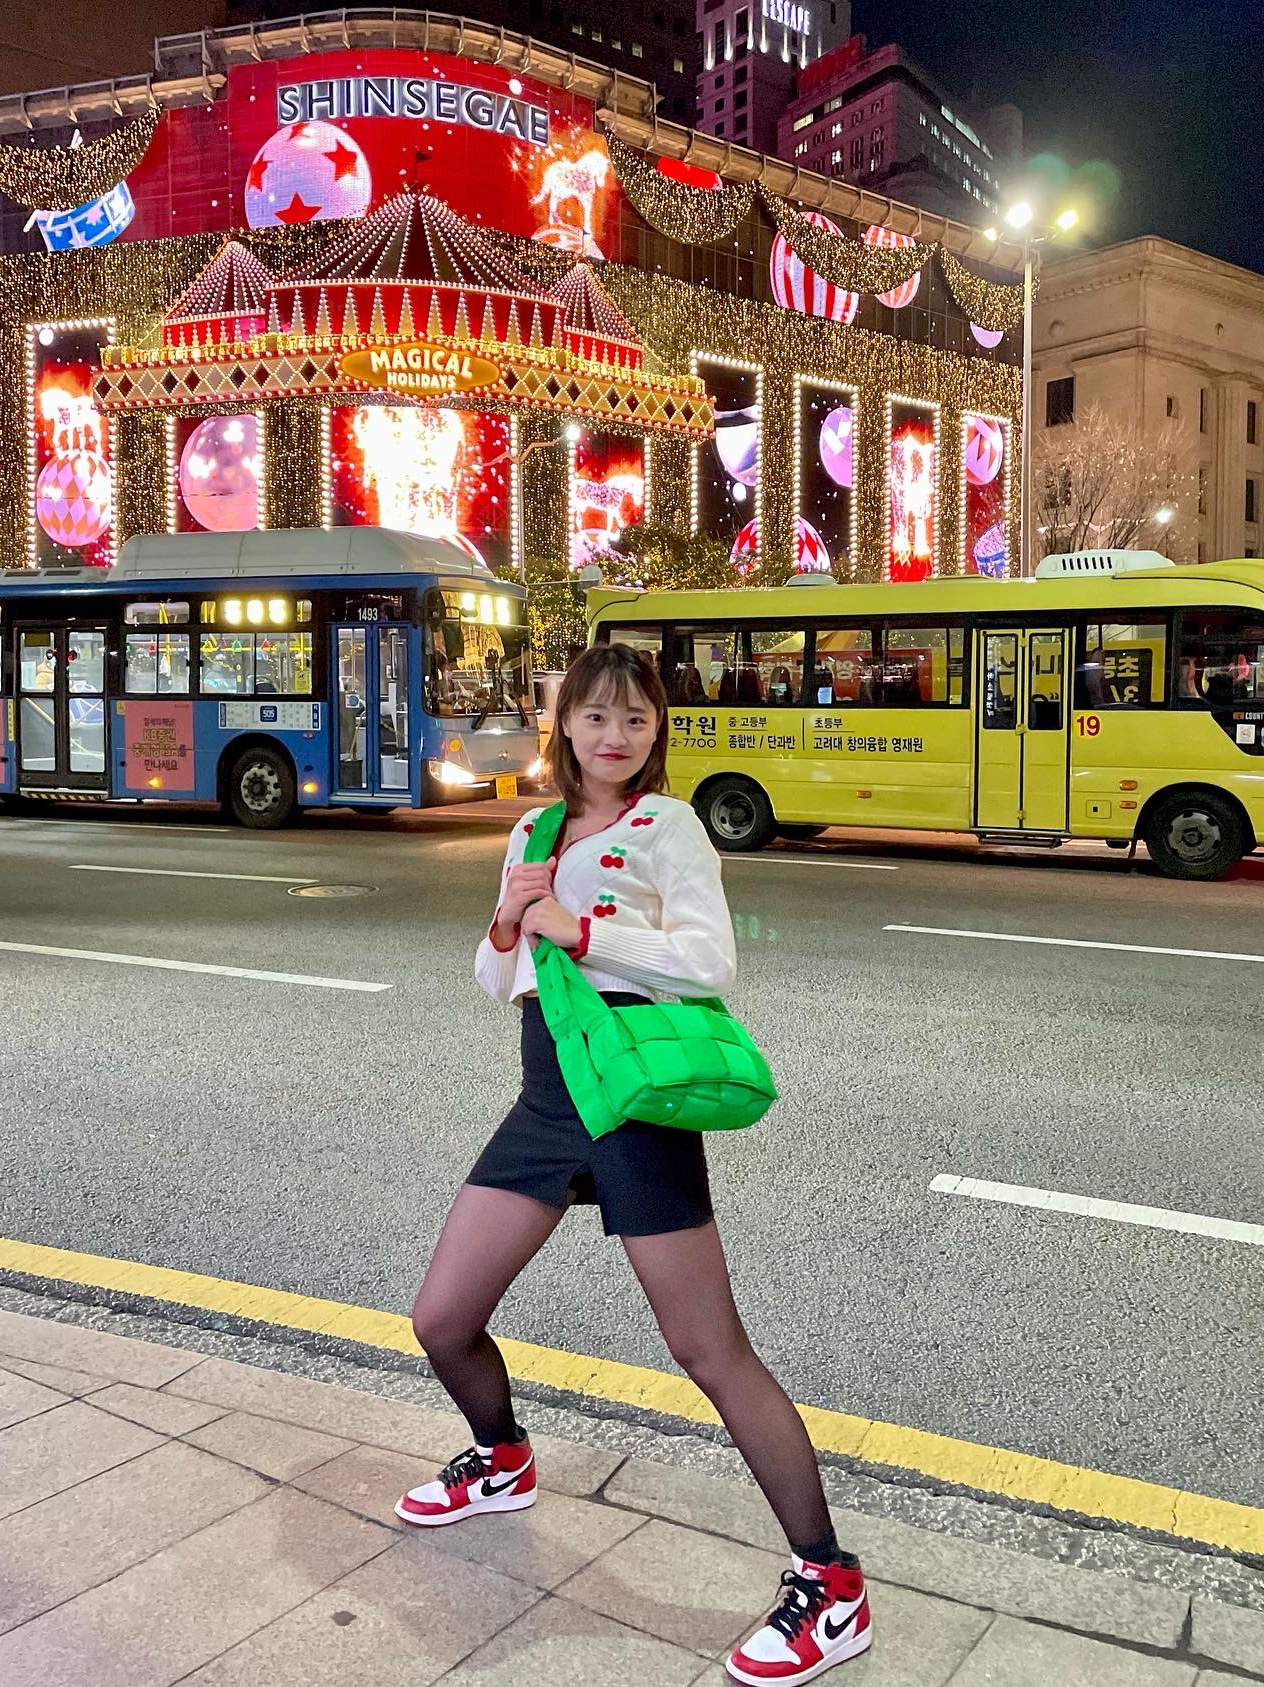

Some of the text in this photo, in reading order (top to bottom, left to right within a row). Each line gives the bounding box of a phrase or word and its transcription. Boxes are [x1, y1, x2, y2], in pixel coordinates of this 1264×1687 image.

[279, 77, 548, 145] SHINSEGAE
[370, 348, 473, 378] MAGICAL
[387, 371, 457, 389] HOLIDAYS
[357, 607, 378, 621] 1493
[262, 709, 275, 718] 505
[670, 716, 716, 735] 학원
[814, 718, 842, 729] 초등부
[1076, 715, 1101, 736] 19
[670, 738, 717, 748] 2-7700
[728, 735, 796, 750] 종합반 / 단과반
[813, 736, 923, 752] 고려대 창의융합 영재원
